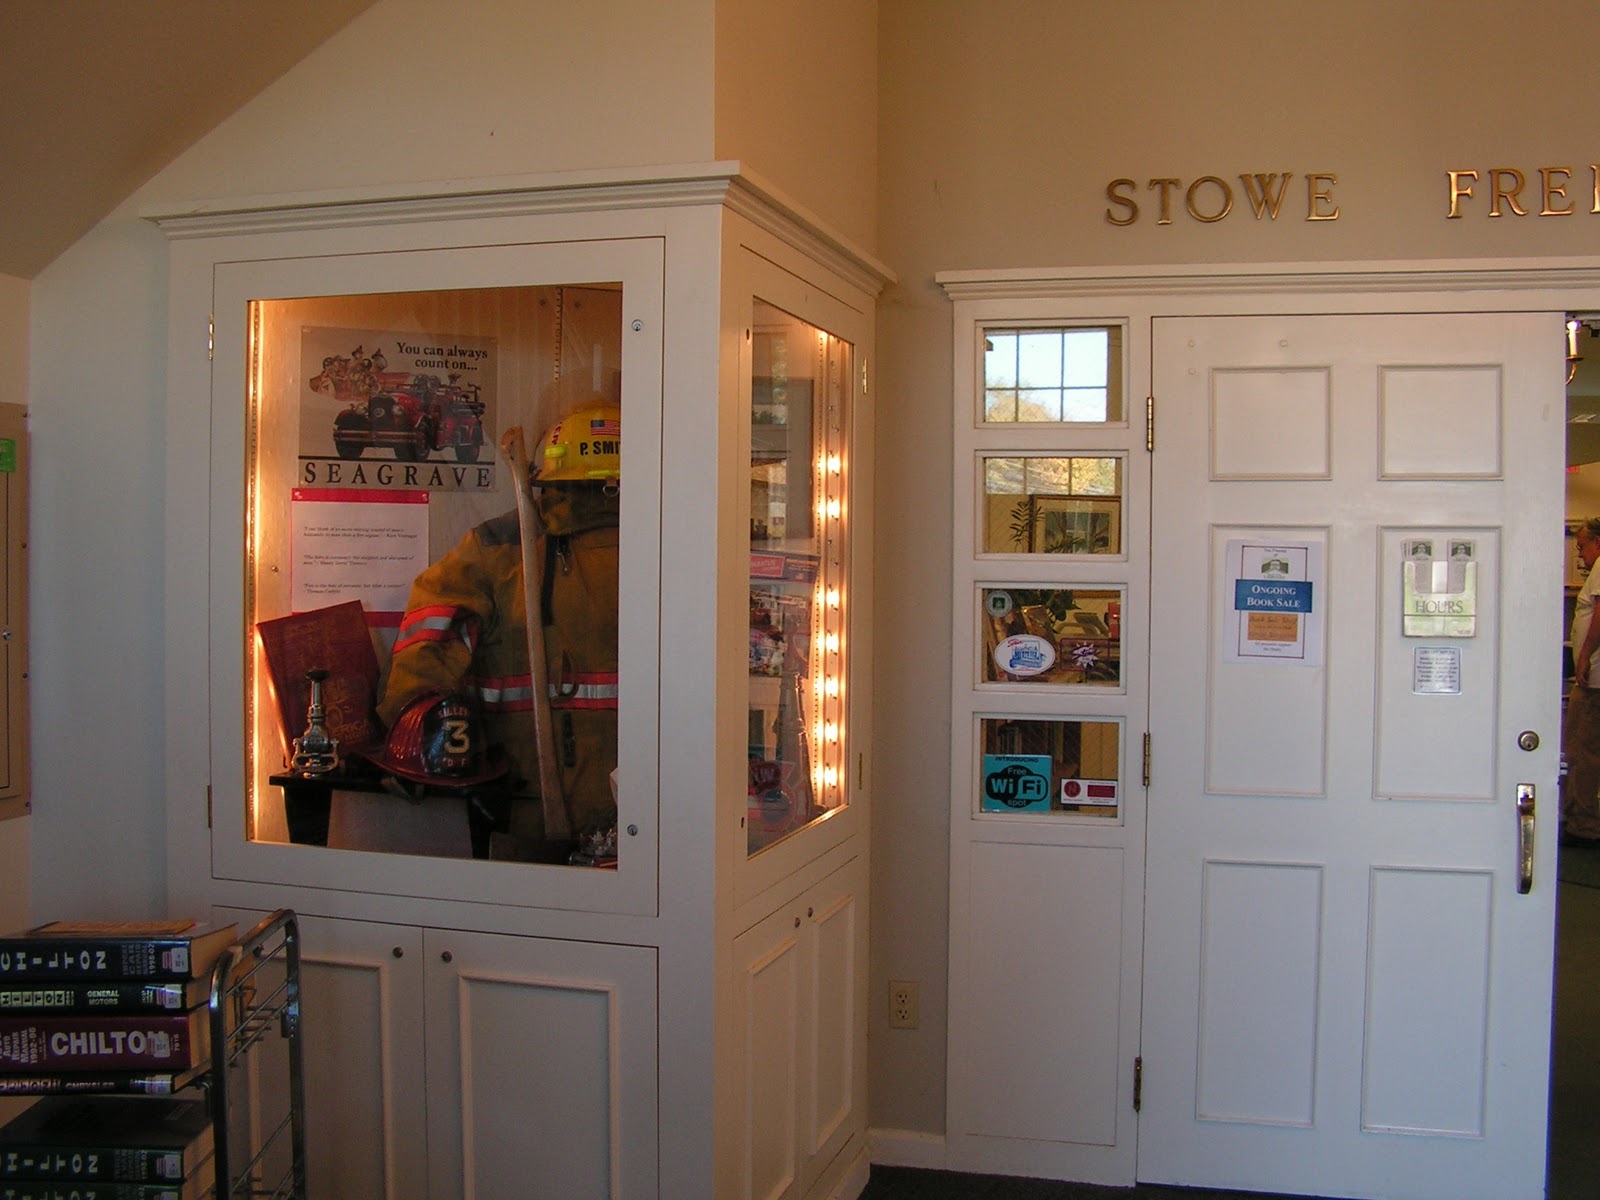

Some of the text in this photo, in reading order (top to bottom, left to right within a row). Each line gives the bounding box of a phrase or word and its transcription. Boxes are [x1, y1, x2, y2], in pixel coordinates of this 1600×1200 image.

[1104, 171, 1341, 227] STOWE
[396, 341, 488, 361] You can always
[414, 358, 449, 369] count
[579, 440, 620, 457] P. SMI
[303, 461, 491, 489] SEAGRAVE
[1251, 585, 1297, 595] ONGOING
[1246, 597, 1301, 609] BOOK SALE
[1415, 600, 1464, 614] HOURS
[443, 719, 471, 754] 3
[1007, 767, 1027, 775] Free
[1007, 799, 1027, 808] spot
[0, 951, 107, 971] CHILTON
[87, 990, 120, 998] GENERAL
[88, 998, 119, 1006] MOTORS
